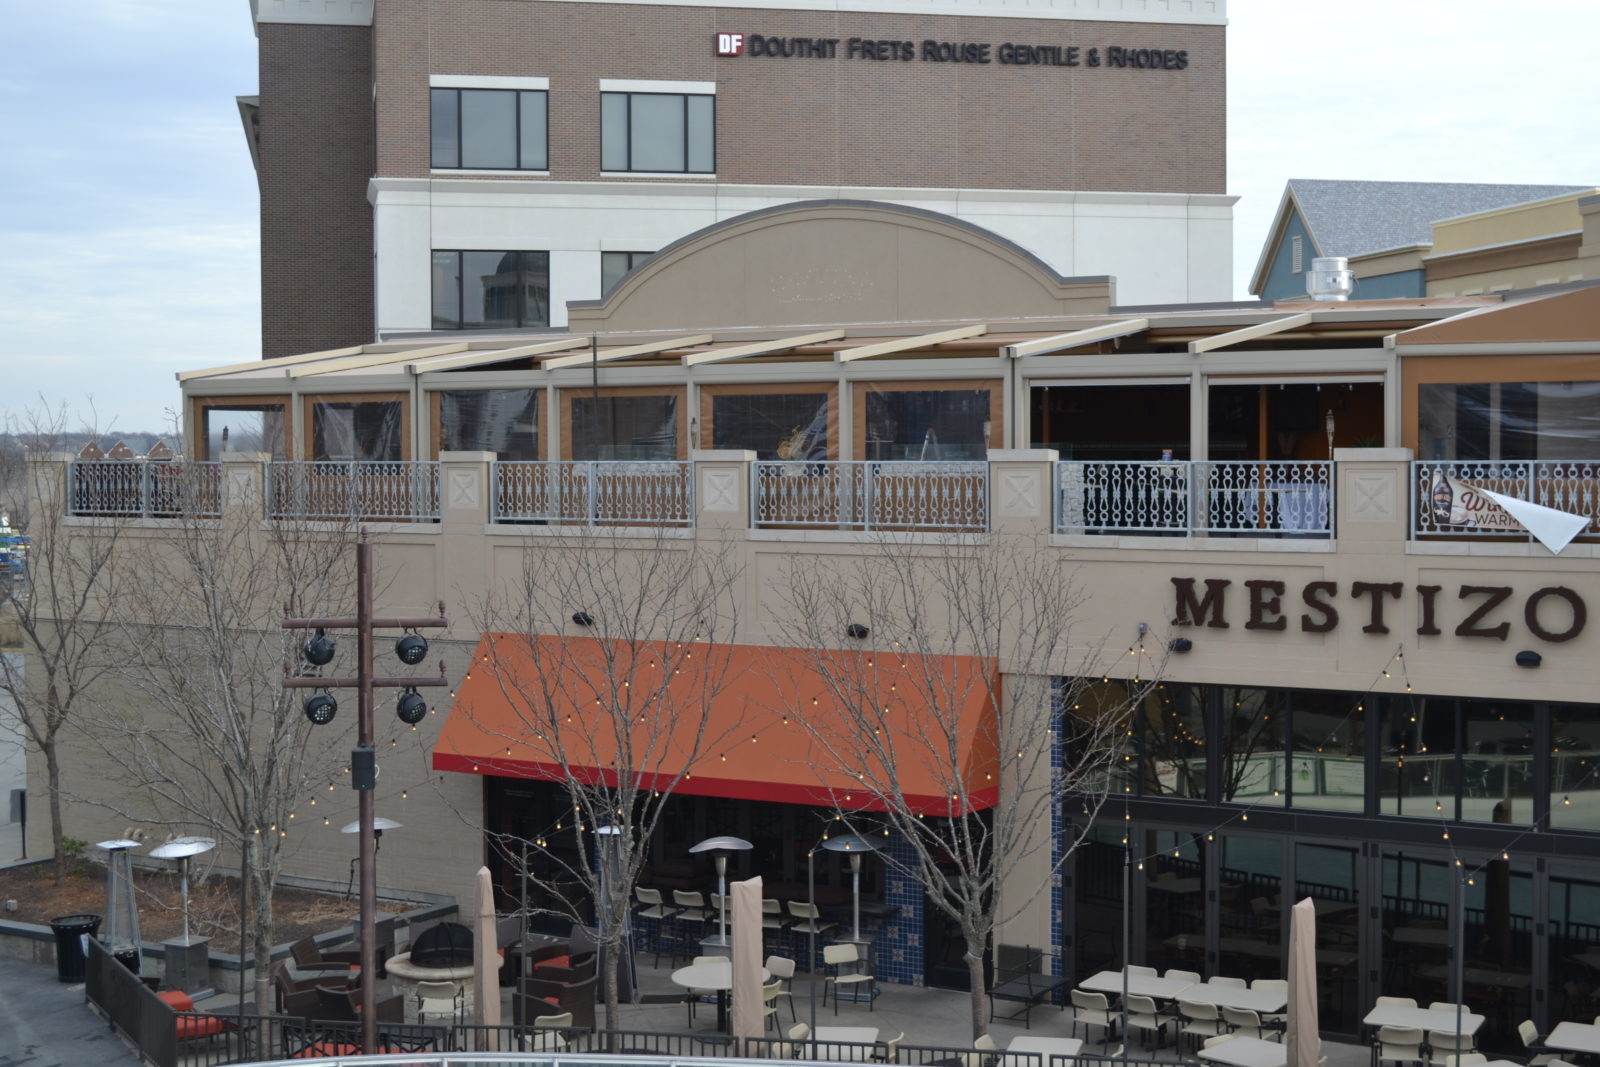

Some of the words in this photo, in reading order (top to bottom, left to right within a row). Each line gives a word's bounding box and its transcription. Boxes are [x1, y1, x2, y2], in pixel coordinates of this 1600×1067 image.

[718, 34, 743, 54] DF
[749, 34, 840, 59] DOUTHIT
[848, 37, 915, 61] FRETS
[923, 40, 992, 64] ROUSE
[999, 42, 1080, 66] GENTILE
[1087, 48, 1101, 67] &
[1108, 46, 1189, 70] RHODES
[1461, 491, 1507, 514] Win
[1170, 576, 1587, 643] MESTIZO
